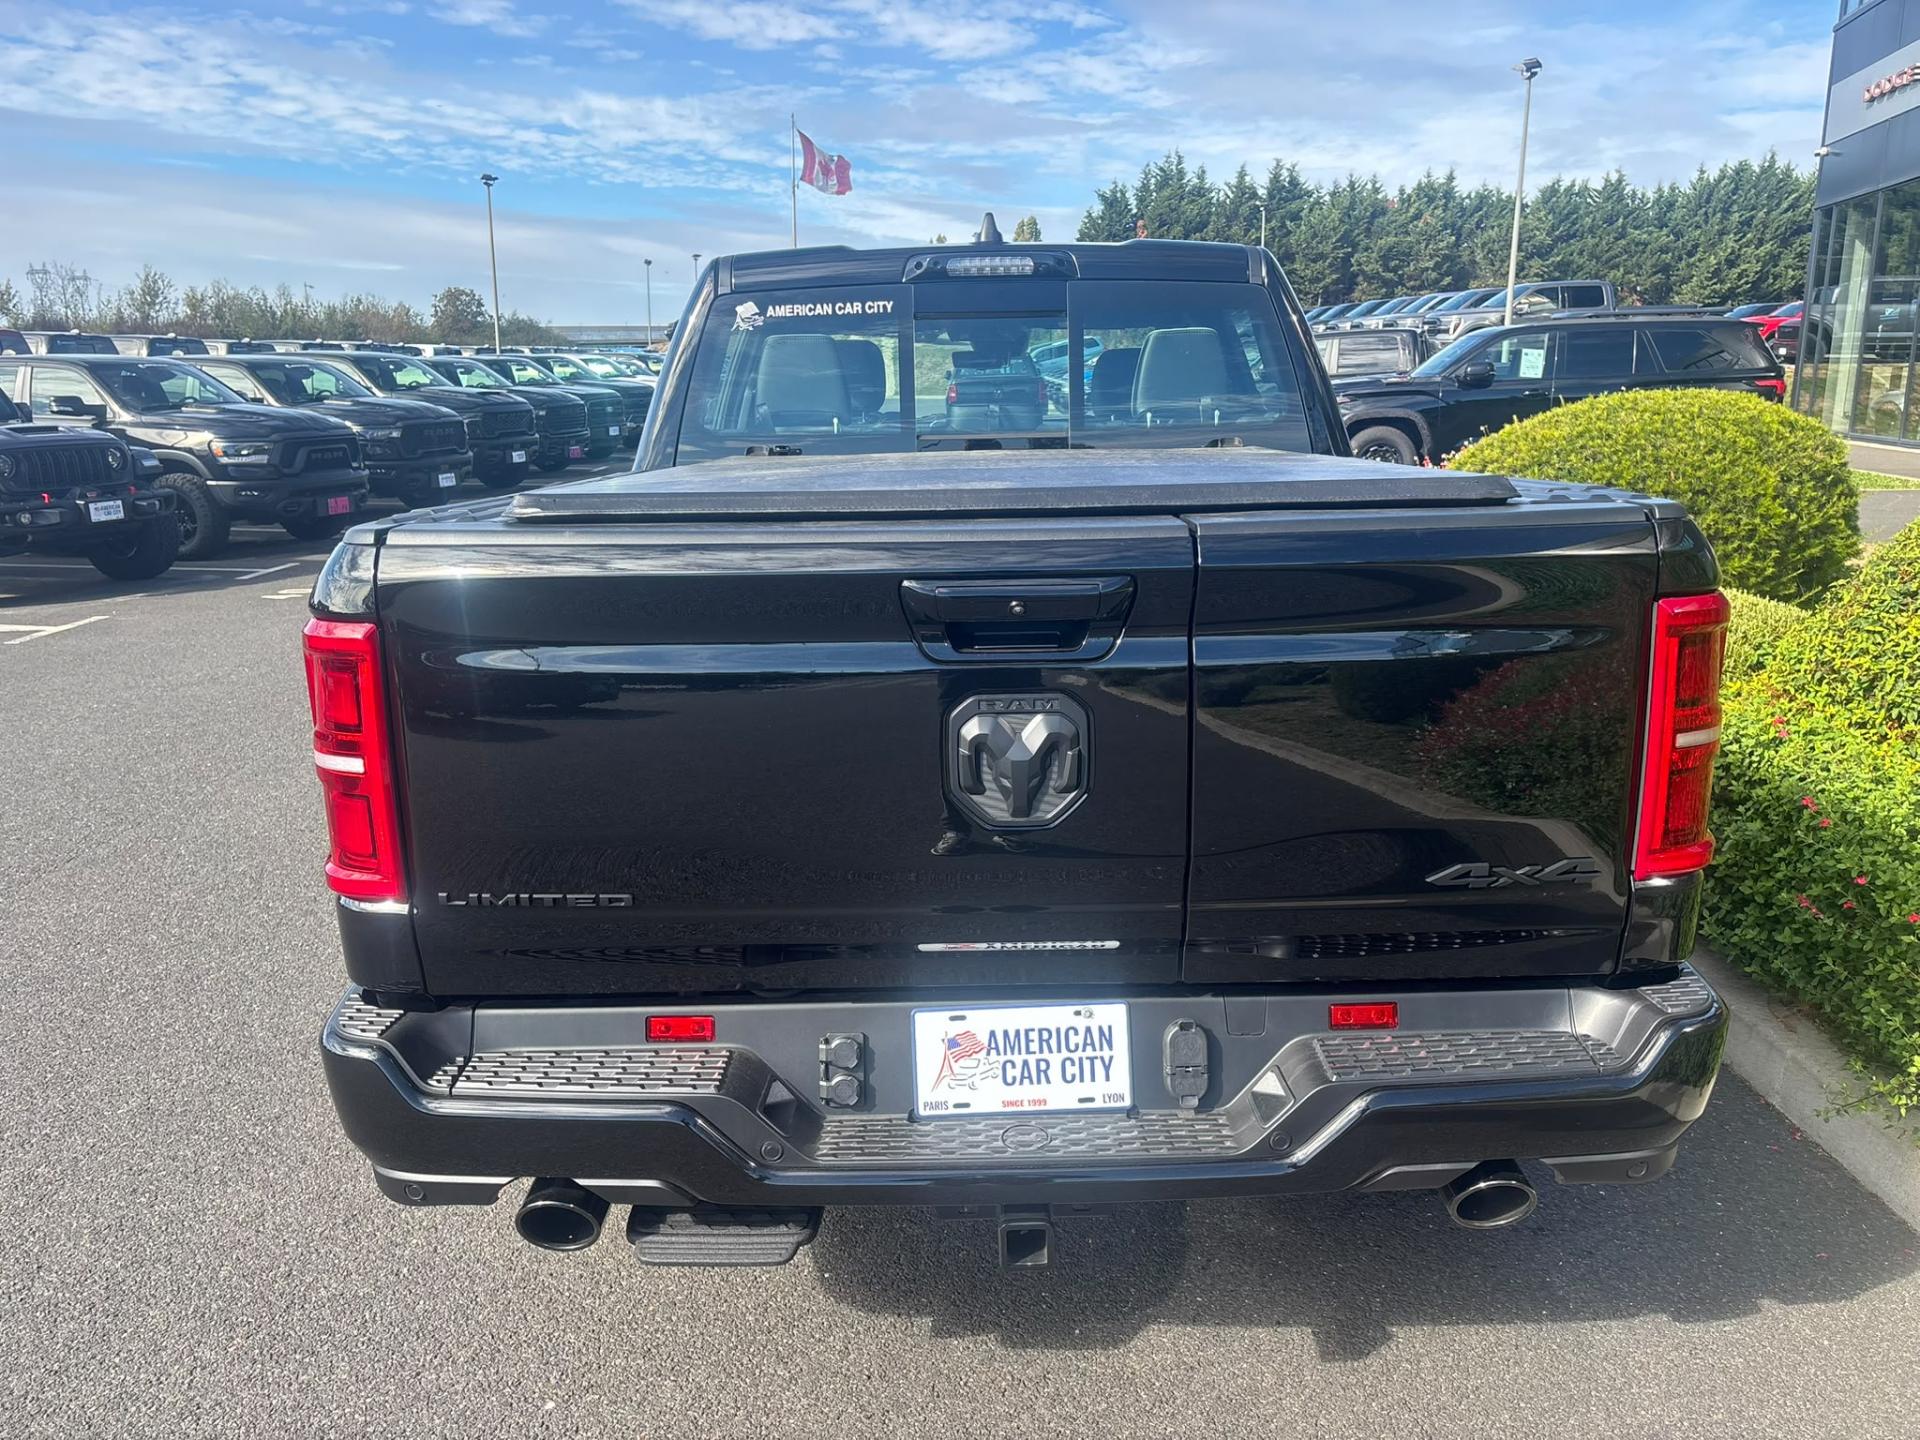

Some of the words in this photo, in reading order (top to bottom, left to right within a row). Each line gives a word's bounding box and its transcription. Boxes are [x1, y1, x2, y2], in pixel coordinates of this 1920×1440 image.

[766, 303, 832, 317] AMERICAN
[835, 302, 862, 315] CAR
[865, 301, 893, 313] CITY
[978, 698, 1060, 710] RAM
[438, 893, 633, 906] LIMITED
[986, 1025, 1113, 1056] AMERICAN
[1002, 1058, 1051, 1086] CAR
[1061, 1055, 1114, 1084] CITY
[1001, 1100, 1025, 1108] SINCE
[1028, 1098, 1048, 1107] 1999
[1102, 1093, 1125, 1104] LYON
[923, 1101, 949, 1111] PARIS
